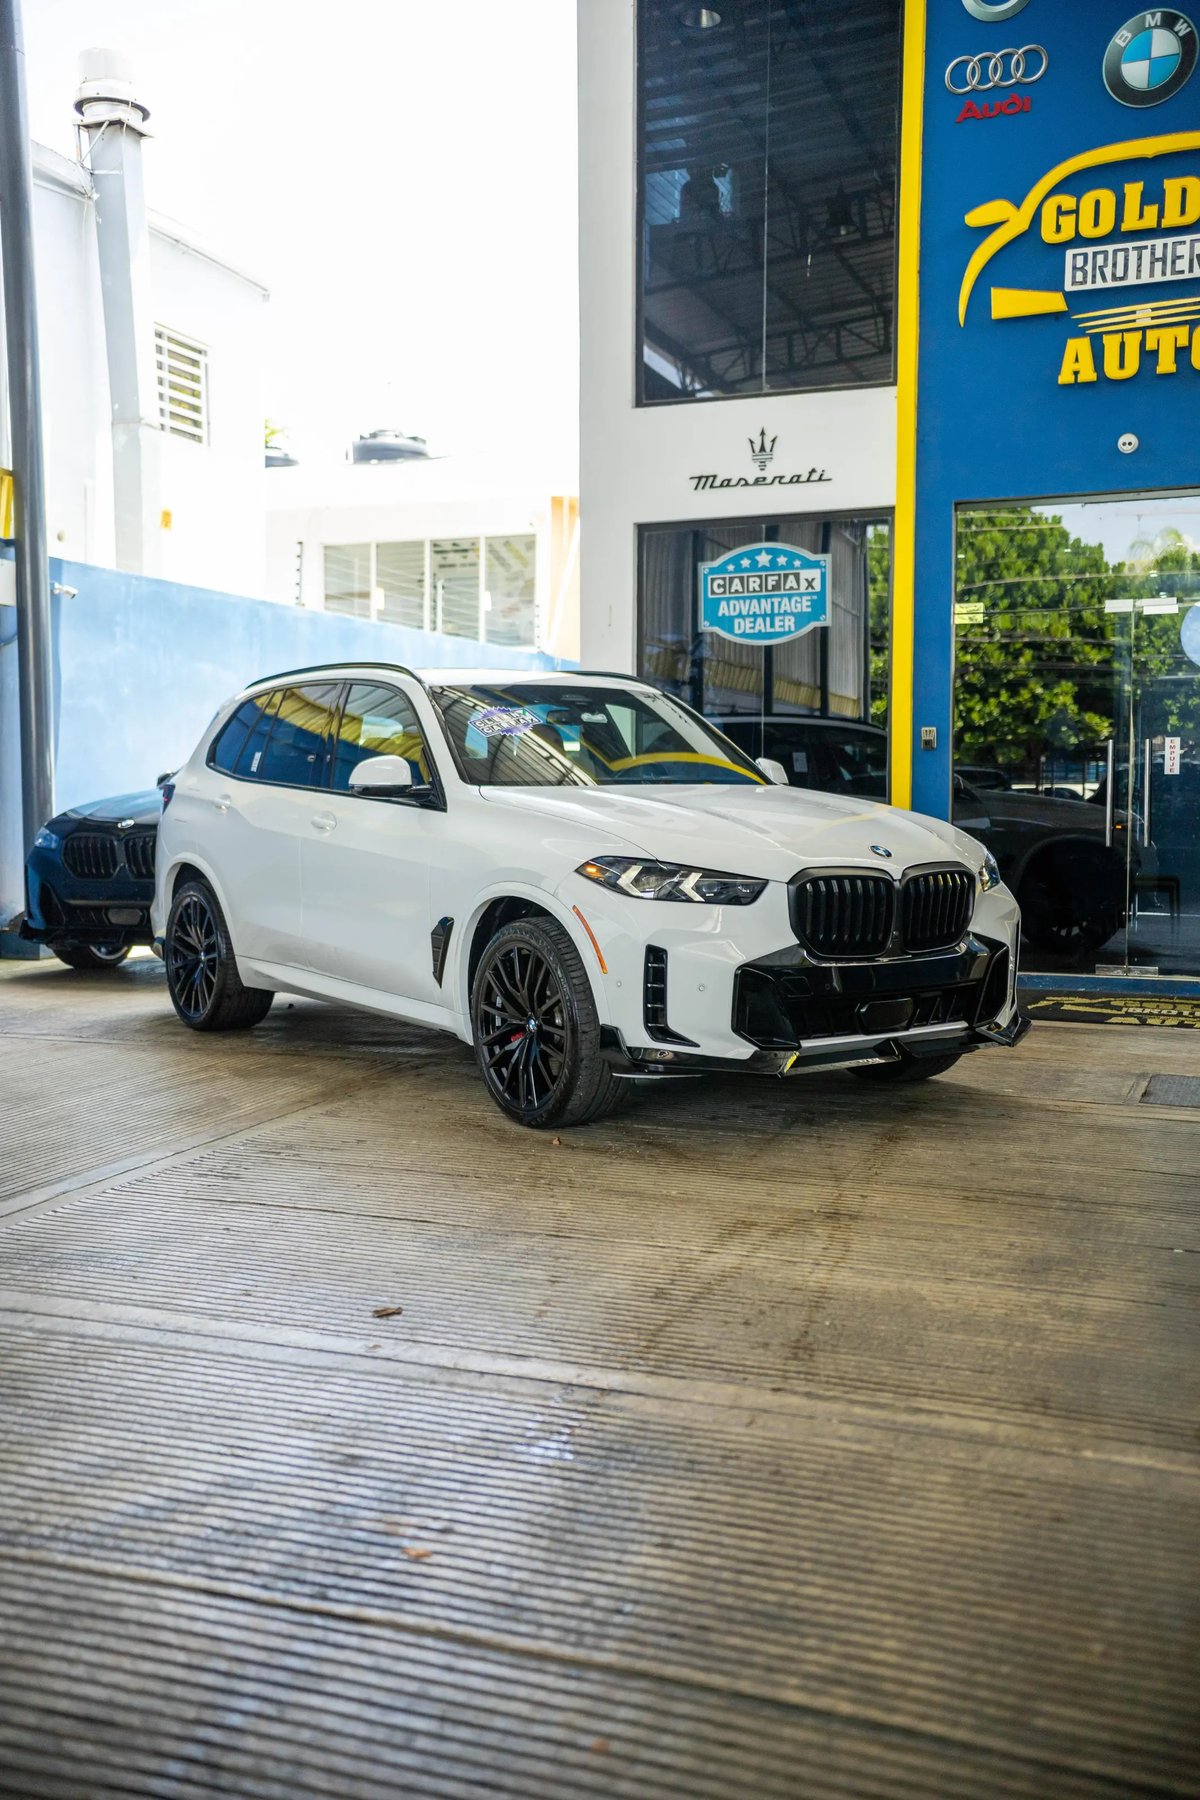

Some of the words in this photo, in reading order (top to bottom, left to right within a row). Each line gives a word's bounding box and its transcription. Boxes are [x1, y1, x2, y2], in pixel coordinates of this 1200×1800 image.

[1115, 13, 1191, 48] BMW
[955, 93, 1031, 123] Audi
[1040, 176, 1200, 244] GOLD
[1057, 324, 1200, 385] AUT
[689, 467, 832, 491] Maserati
[711, 574, 818, 594] CARFAX
[734, 616, 796, 634] DEALER
